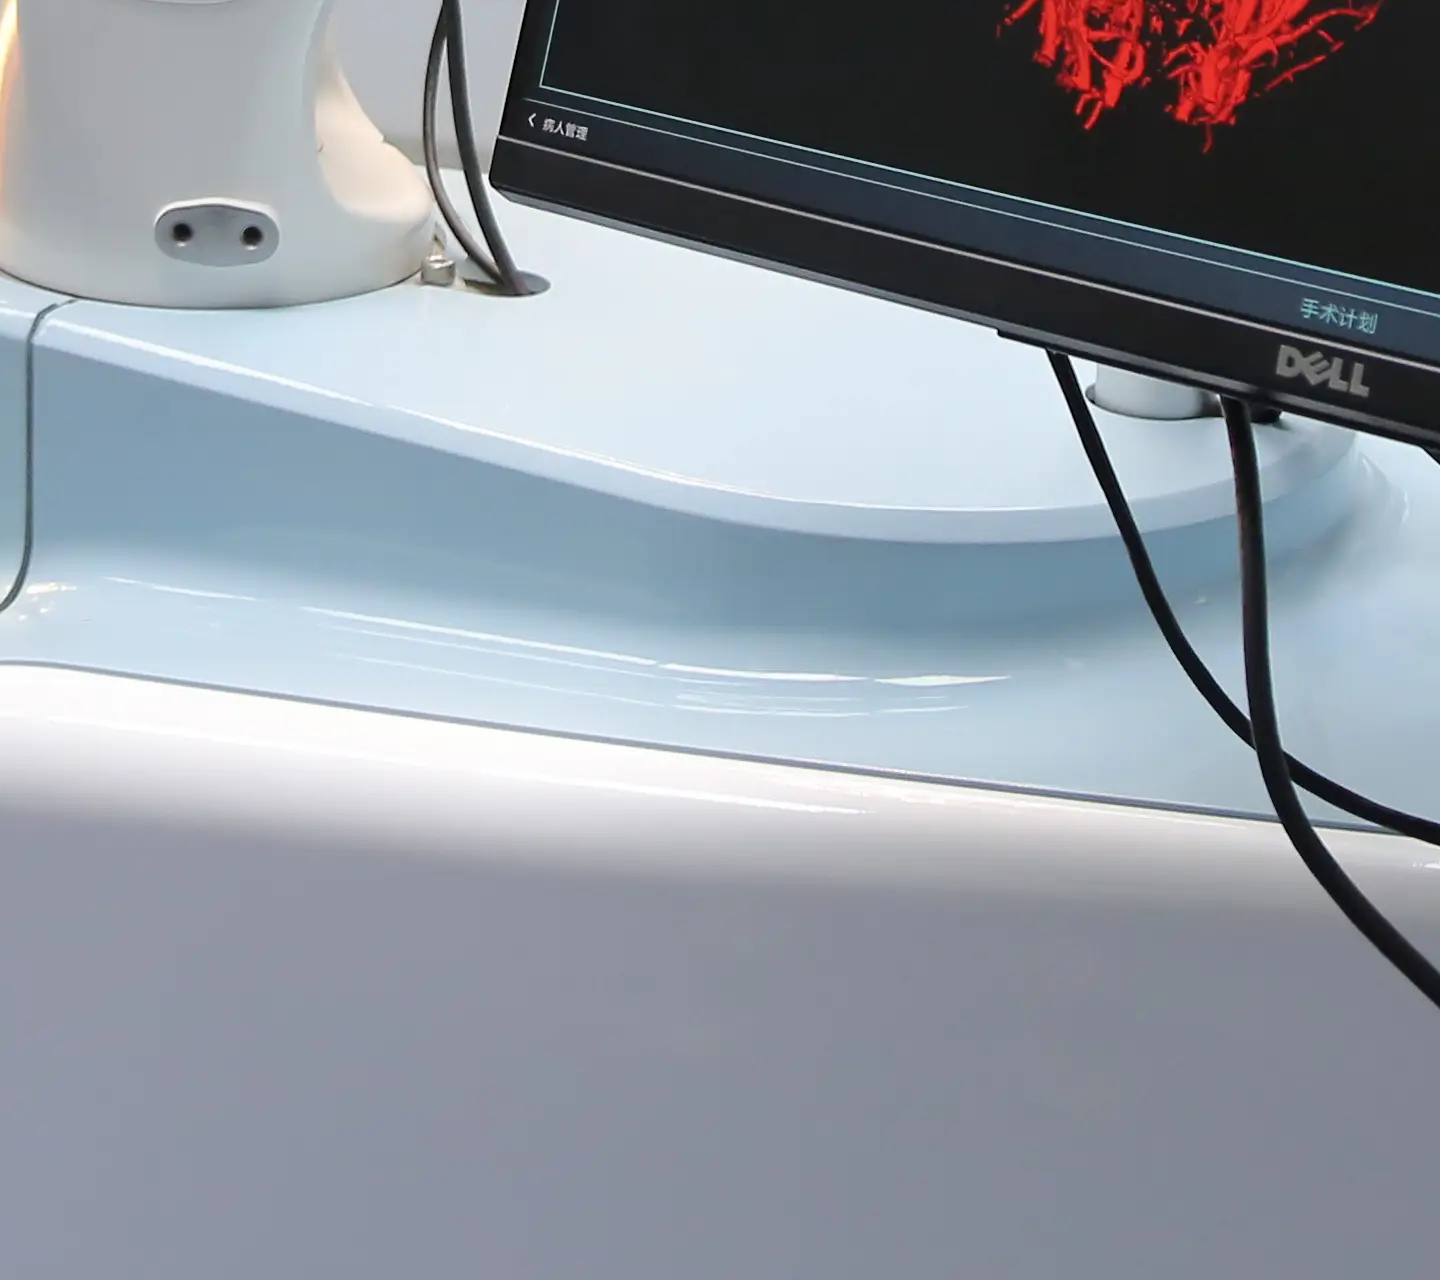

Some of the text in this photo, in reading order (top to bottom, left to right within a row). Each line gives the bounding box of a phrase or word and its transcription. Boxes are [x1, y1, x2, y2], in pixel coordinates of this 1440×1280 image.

[542, 117, 589, 141] 病人管理
[1300, 297, 1379, 335] 手术计划
[1275, 343, 1371, 397] DELL
